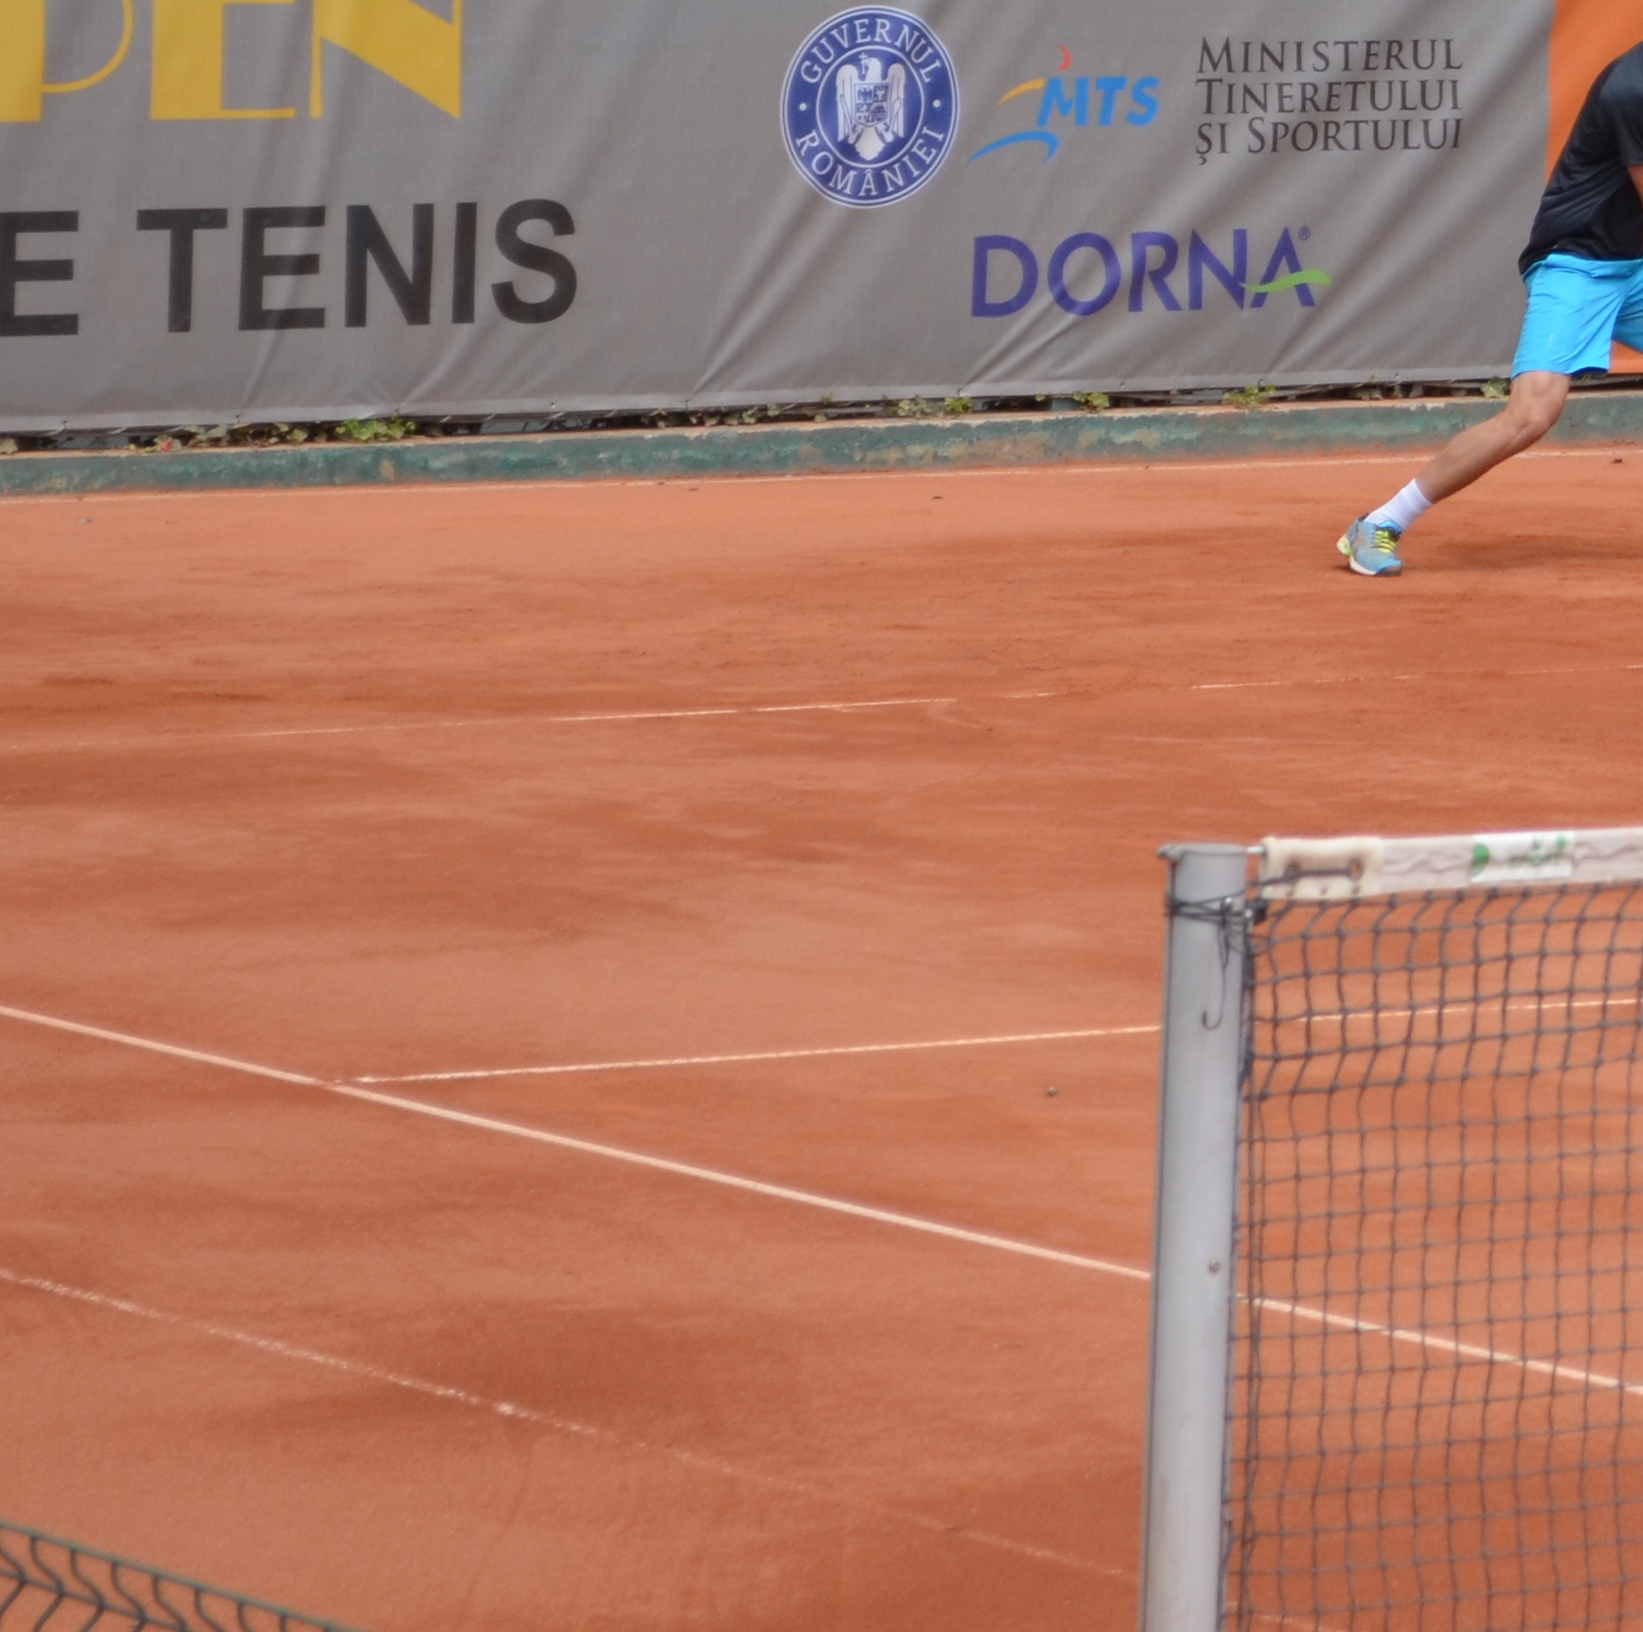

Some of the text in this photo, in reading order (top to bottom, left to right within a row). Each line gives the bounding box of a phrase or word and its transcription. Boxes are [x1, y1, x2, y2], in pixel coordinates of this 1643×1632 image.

[800, 18, 941, 84] GUVERNUL
[1196, 36, 1463, 74] MINISTERUL
[1037, 76, 1159, 127] MTS
[1196, 77, 1462, 115] TINERETULUI
[1247, 116, 1462, 154] SPORTULUI
[796, 126, 944, 196] ROMÂNIEI
[136, 199, 577, 333] TENIS
